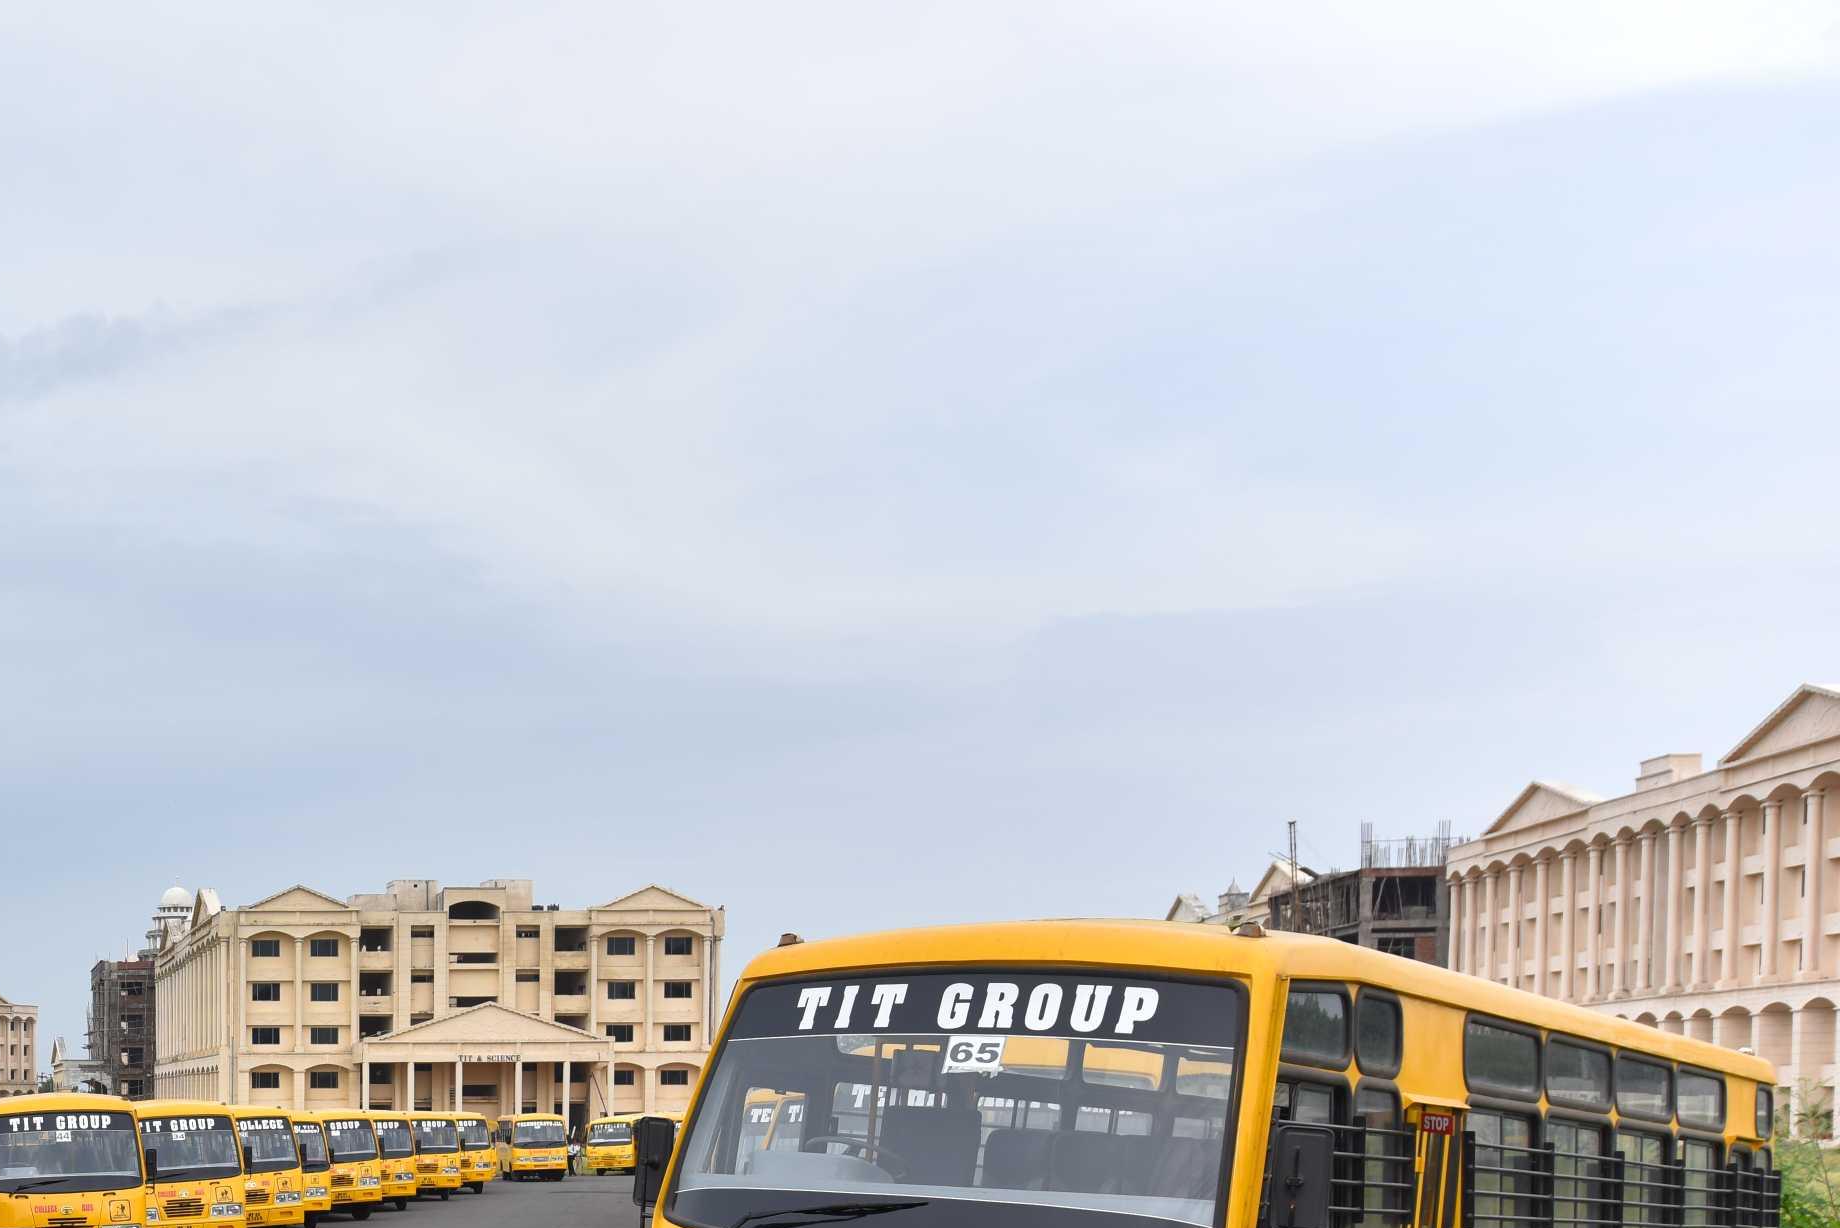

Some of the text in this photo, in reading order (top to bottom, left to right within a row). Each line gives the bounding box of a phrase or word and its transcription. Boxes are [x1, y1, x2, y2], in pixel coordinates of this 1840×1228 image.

[796, 982, 1160, 1034] TIT GROUP
[458, 1054, 473, 1062] TIT
[486, 1054, 521, 1062] SCIENCE
[948, 1042, 1002, 1064] 65
[9, 1114, 111, 1132] TIT GROUP
[170, 1118, 215, 1132] GROUP
[329, 1120, 360, 1130] GROUP
[421, 1120, 447, 1128] GROUP
[1423, 1115, 1450, 1132] STOP
[56, 1132, 71, 1141] 44
